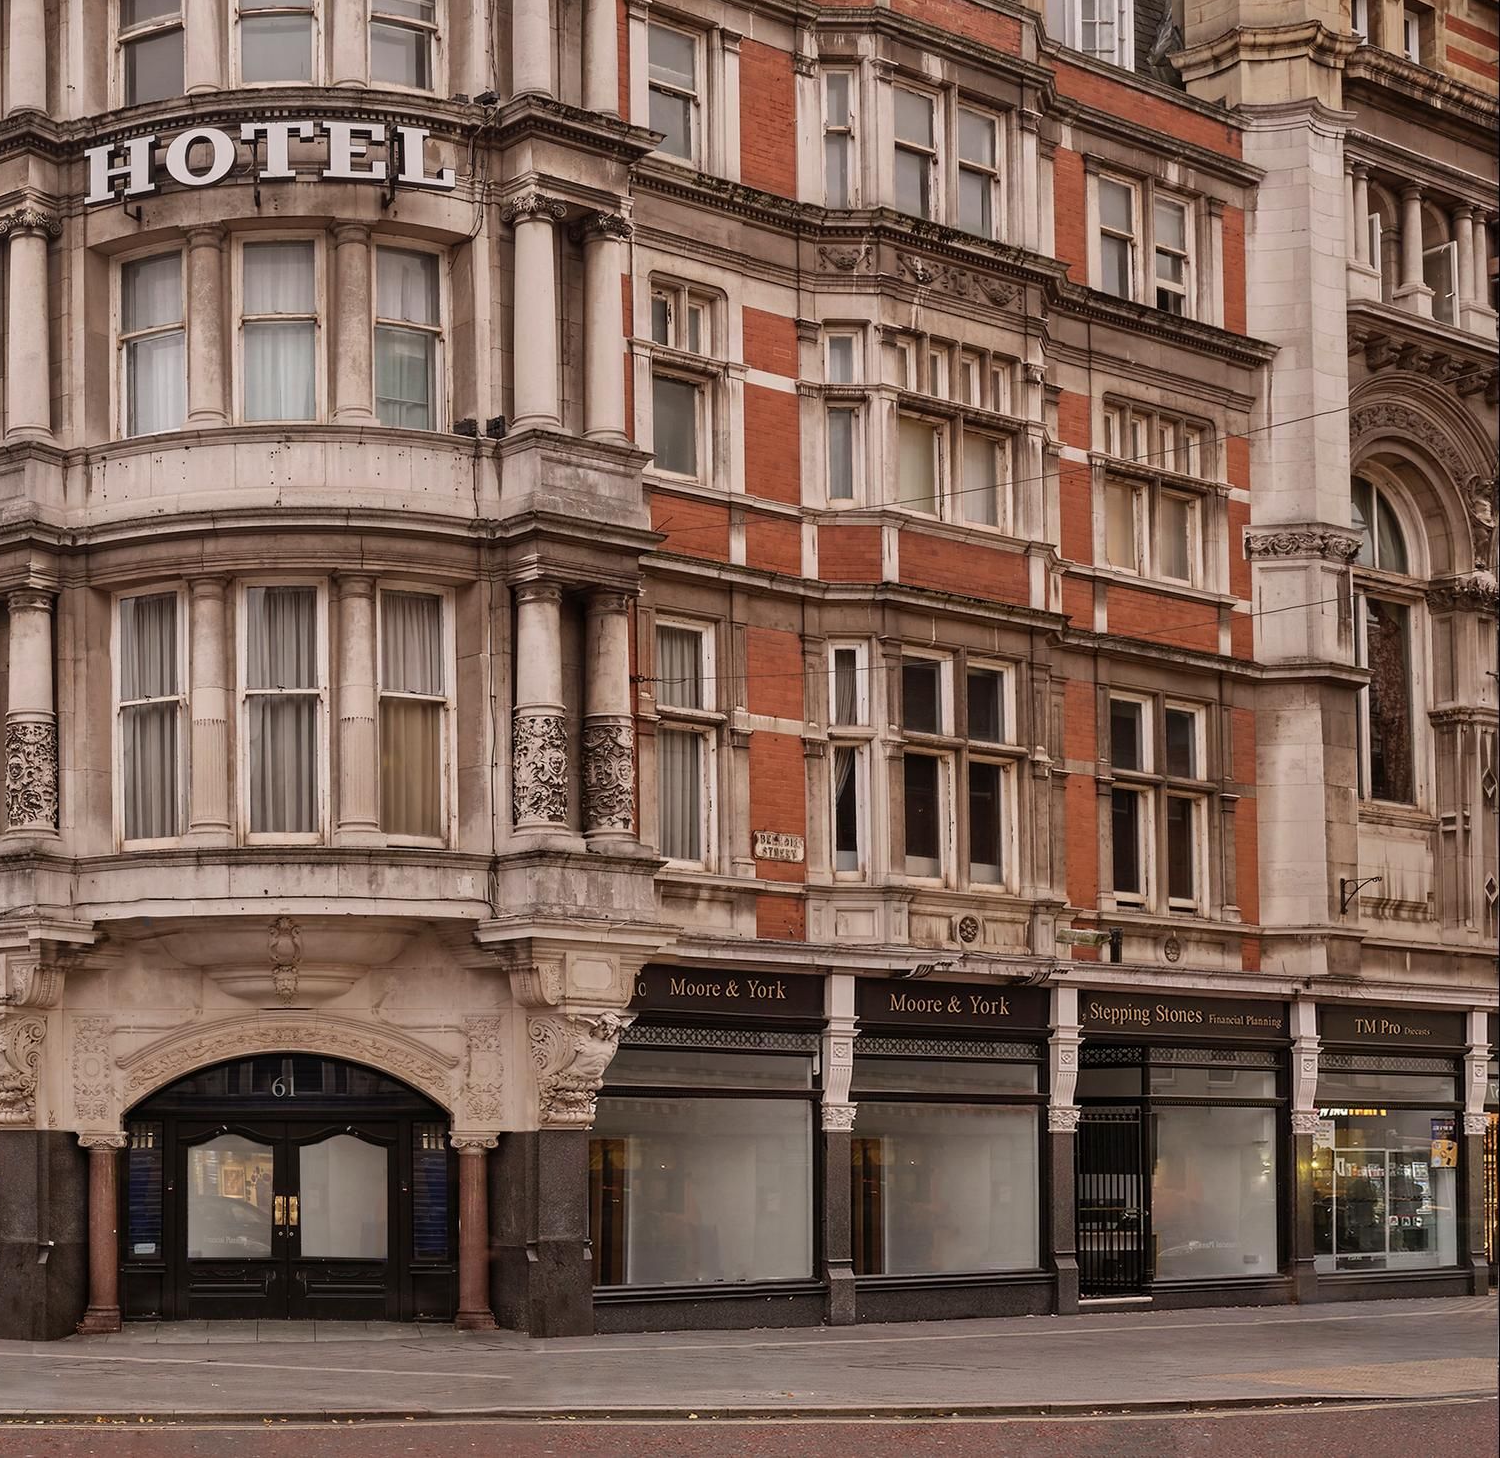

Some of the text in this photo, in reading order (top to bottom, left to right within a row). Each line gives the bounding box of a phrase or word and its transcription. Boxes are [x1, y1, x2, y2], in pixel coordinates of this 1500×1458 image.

[84, 121, 457, 206] HOTEL
[669, 978, 721, 997] Moore
[725, 979, 740, 998] &
[747, 979, 787, 999] York
[889, 993, 1010, 1015] Moore & York
[1089, 1001, 1283, 1030] Stepping Stones Financial Planning
[1355, 1018, 1377, 1034] TM
[1381, 1019, 1401, 1035] Pro
[272, 1075, 297, 1098] 61
